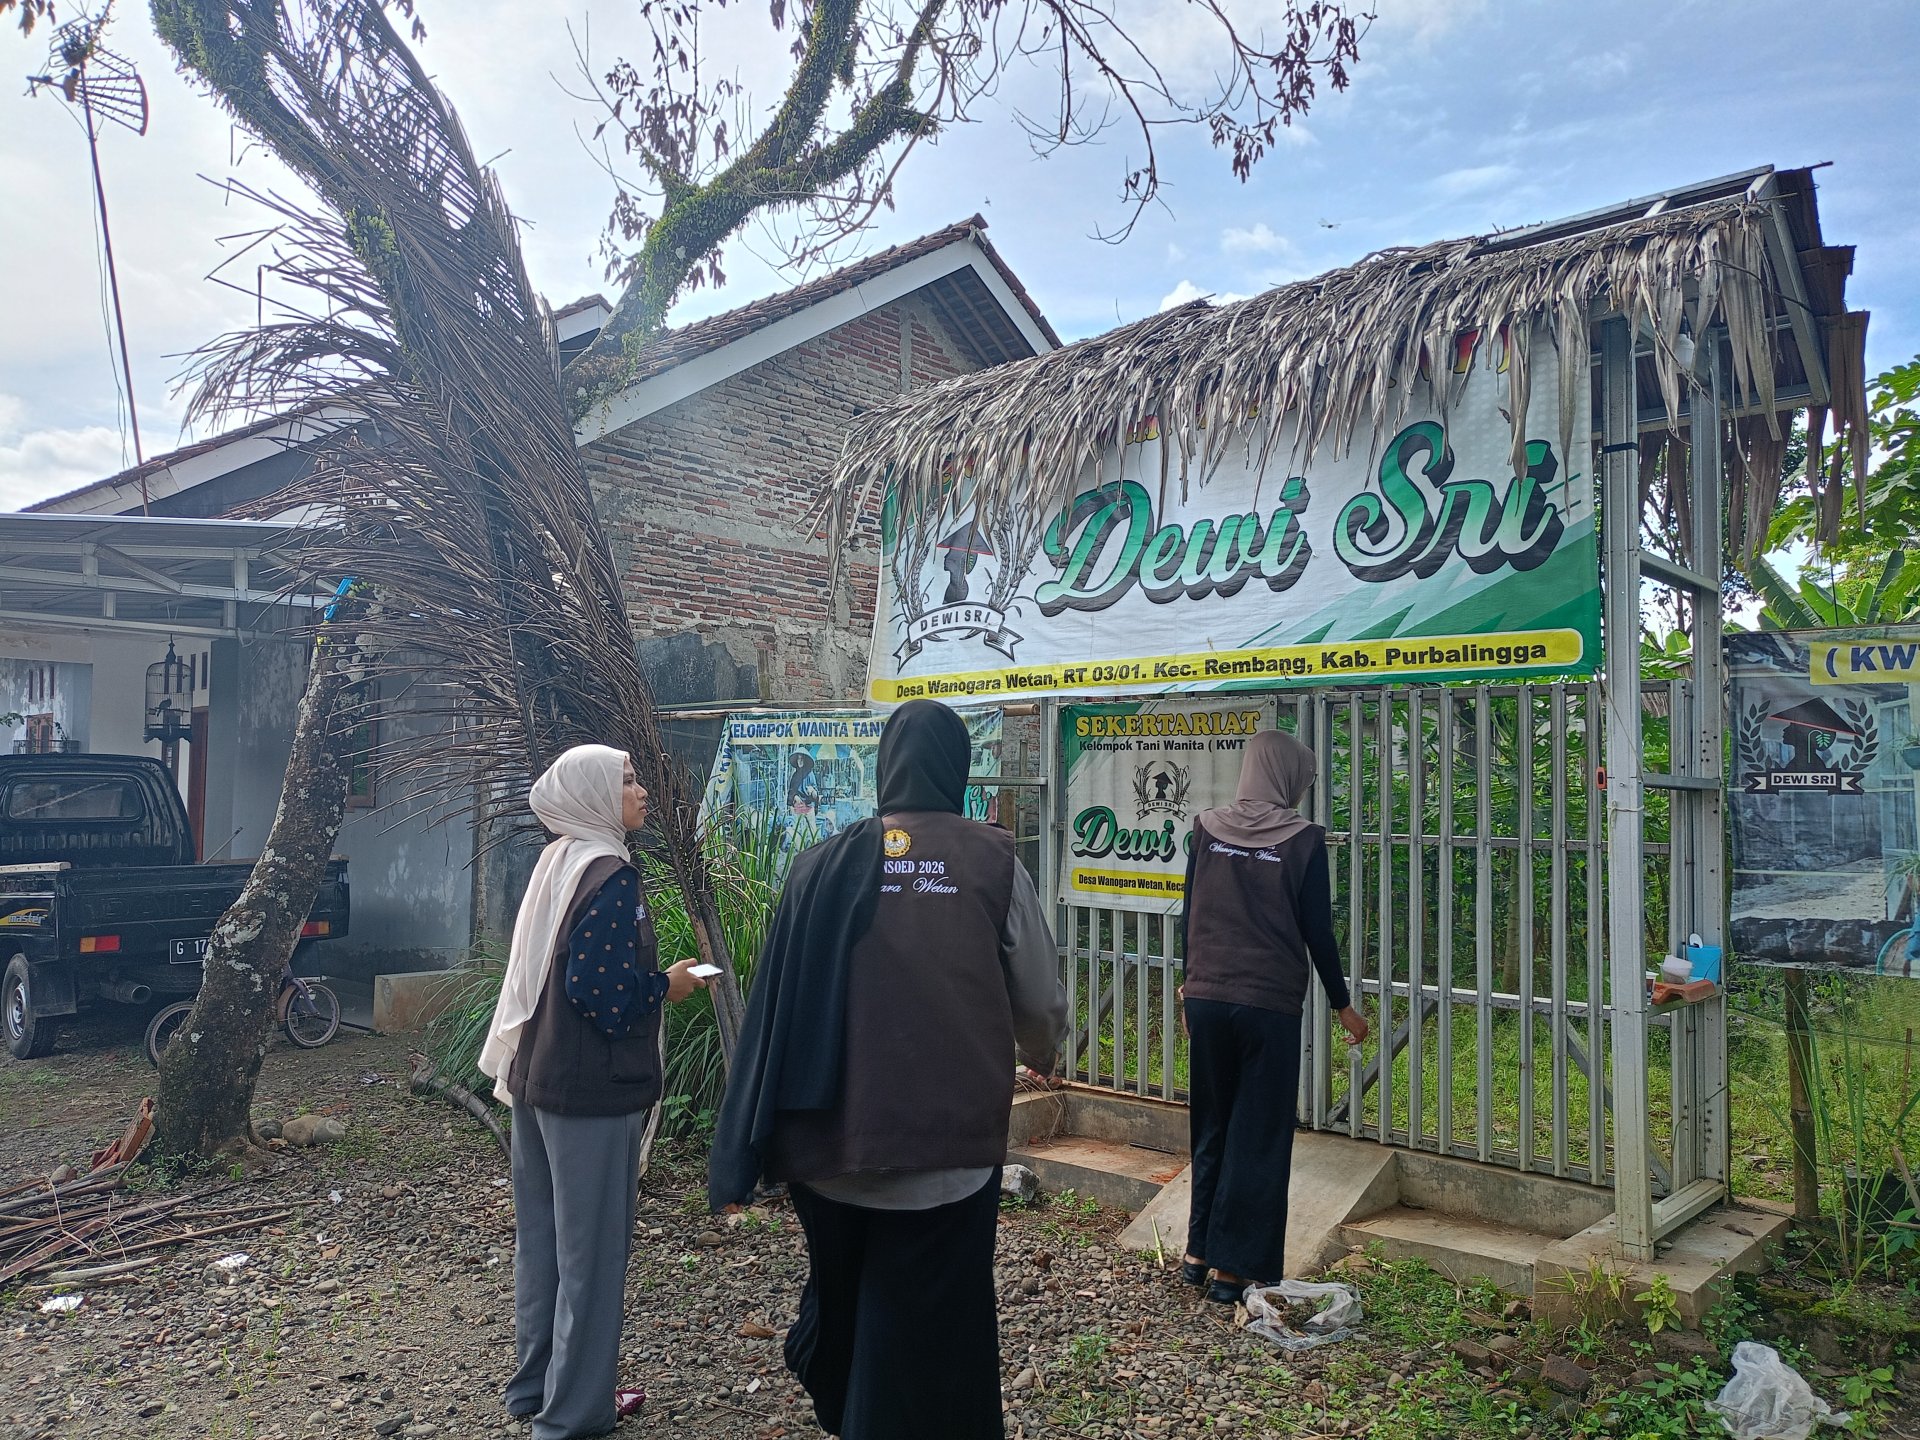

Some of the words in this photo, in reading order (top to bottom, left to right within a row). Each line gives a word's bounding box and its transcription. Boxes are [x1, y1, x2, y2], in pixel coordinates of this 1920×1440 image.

[1034, 477, 1312, 617] Dewi
[1333, 420, 1564, 583] Sri
[920, 611, 959, 632] DEWI
[964, 609, 991, 624] SRI
[1826, 648, 1839, 678] (
[1851, 644, 1920, 672] KW
[897, 683, 924, 699] Desa
[927, 677, 1001, 696] Wanogara
[1005, 672, 1058, 688] Wetan,
[1063, 667, 1088, 684] RT
[1092, 664, 1147, 682] 03/01.
[1154, 661, 1198, 678] Kec.
[1205, 656, 1313, 676] Rembang,
[1321, 650, 1377, 669] Kab.
[1386, 644, 1546, 666] Purbalingga
[798, 721, 849, 738] WANITA
[1076, 711, 1261, 737] SEKERTARIAT
[1079, 740, 1132, 753] Kelompok
[1136, 740, 1160, 750] Tani
[1163, 739, 1205, 750] Wanita
[1208, 739, 1213, 753] (
[1216, 739, 1245, 750] KWT
[1773, 775, 1808, 785] DEWI
[1811, 775, 1835, 785] SRI
[1071, 805, 1177, 863] Dewi
[1254, 849, 1282, 862] Wetan
[918, 861, 945, 875] 2026
[912, 876, 959, 894] Wetan
[1078, 874, 1096, 885] Desa
[1098, 875, 1136, 888] Wanogara
[1137, 878, 1165, 891] Wetan,
[1166, 881, 1185, 892] Keca
[176, 941, 184, 955] G
[194, 939, 207, 954] 17
